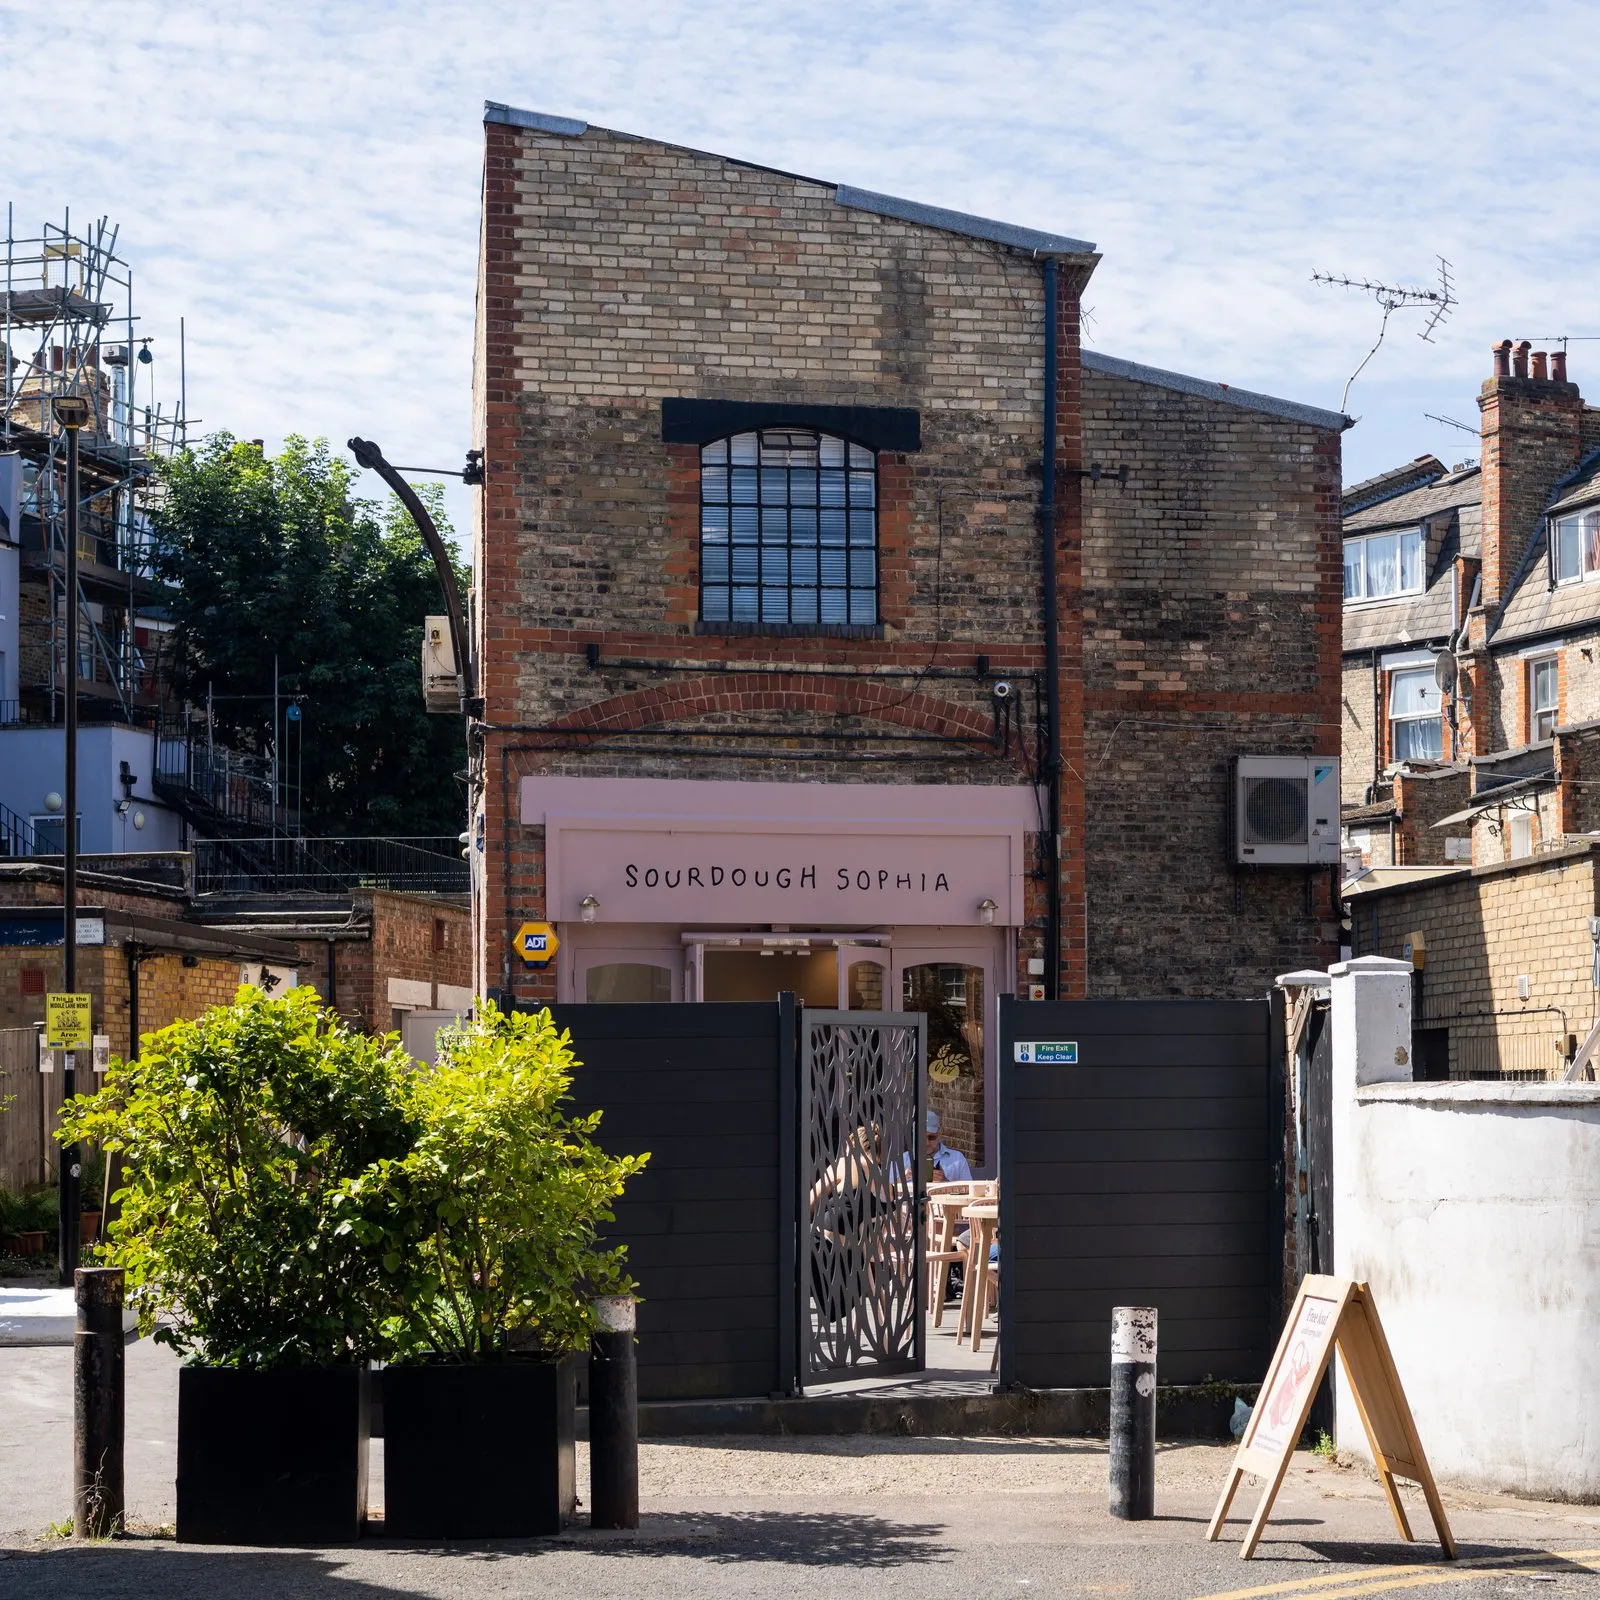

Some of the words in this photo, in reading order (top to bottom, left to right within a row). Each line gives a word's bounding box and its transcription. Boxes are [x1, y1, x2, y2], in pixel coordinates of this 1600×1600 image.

[625, 863, 816, 889] SOURDOUGH
[837, 868, 950, 892] SOPHIA
[525, 937, 546, 948] ADT
